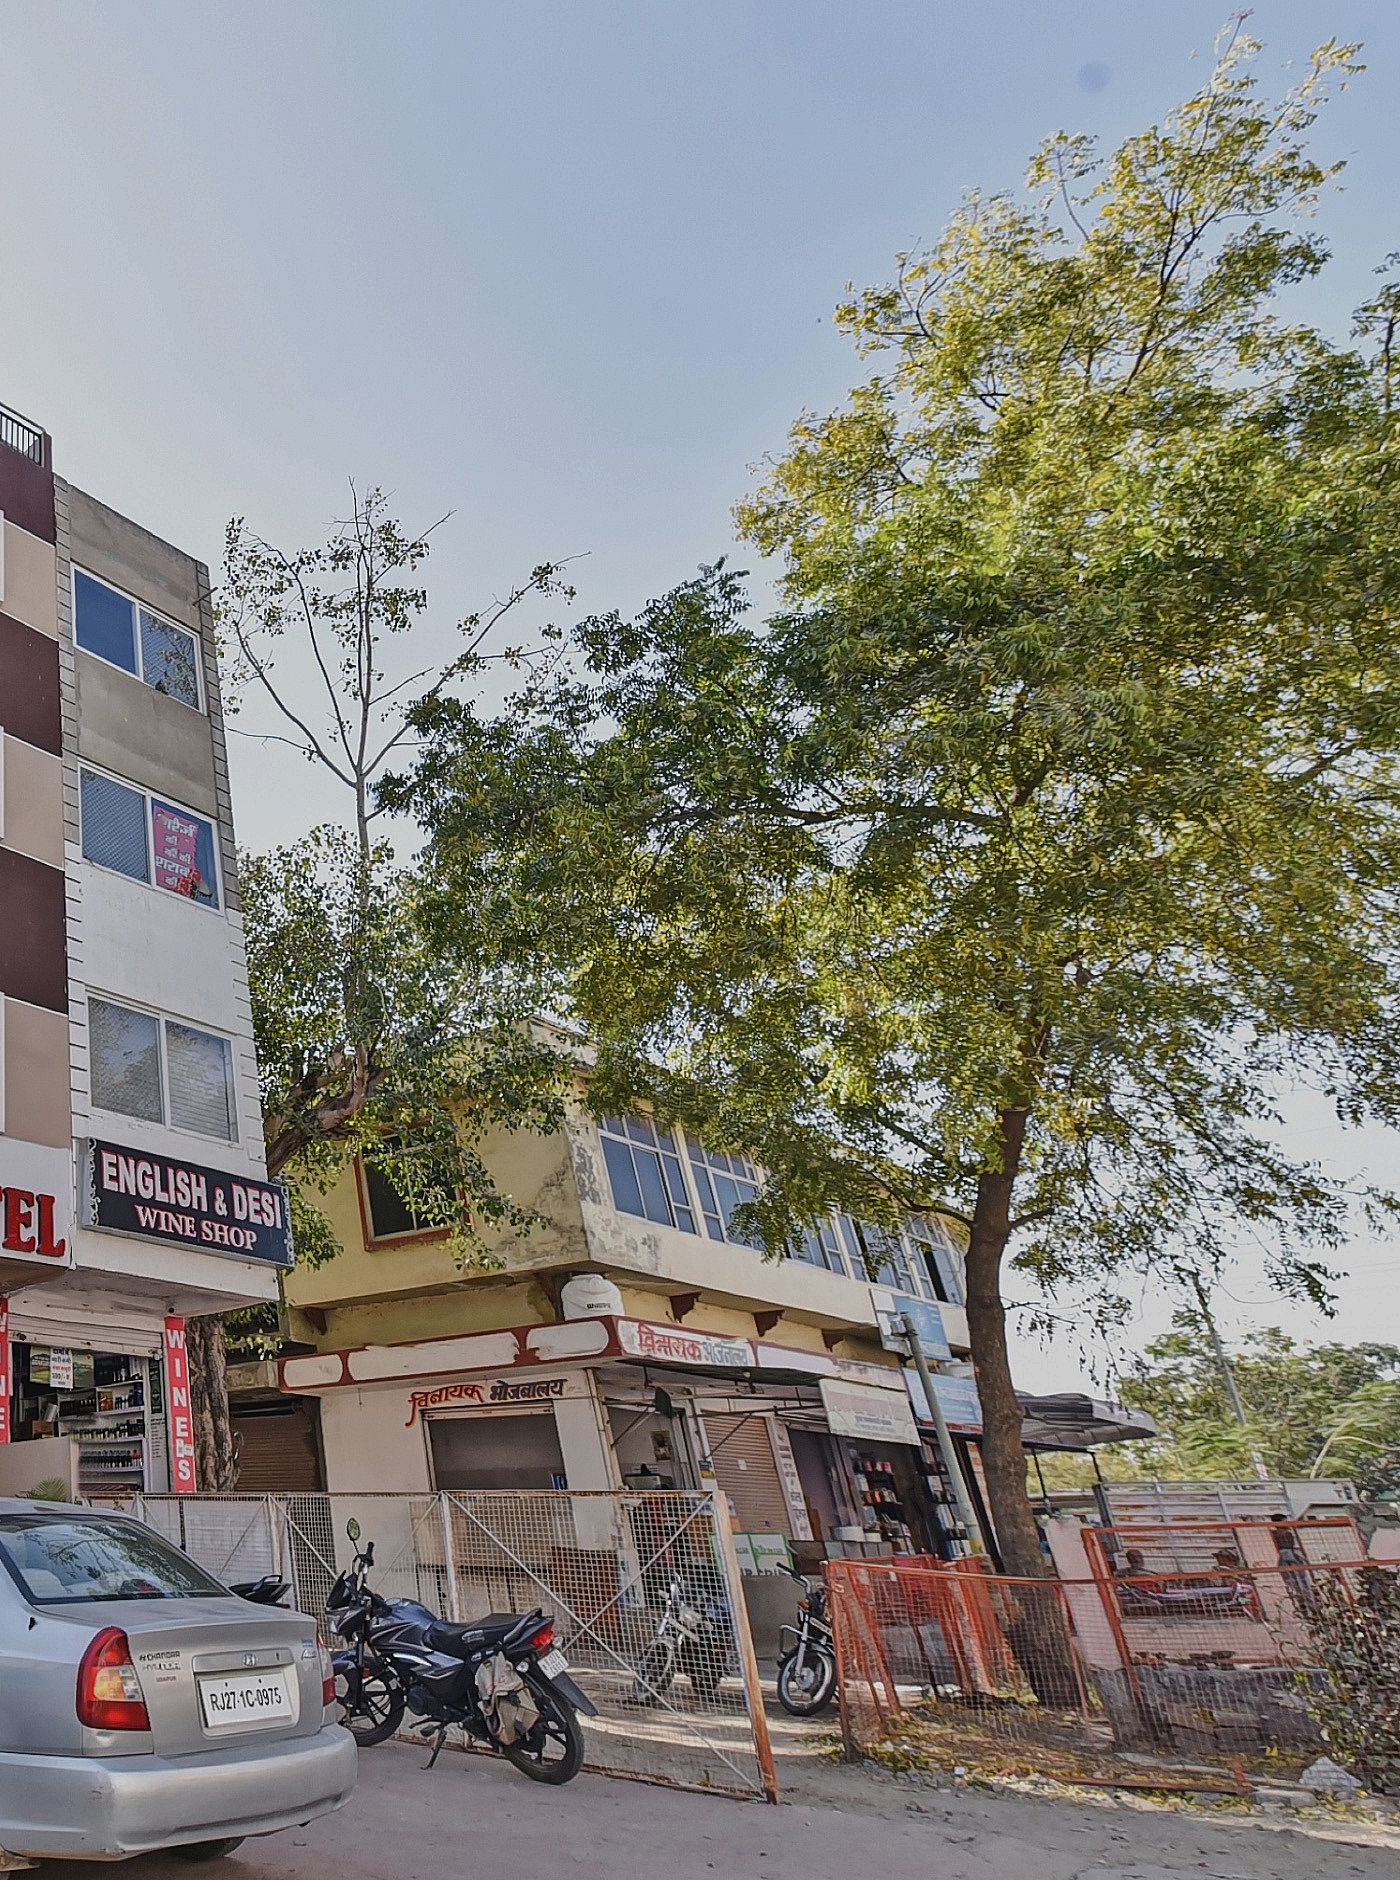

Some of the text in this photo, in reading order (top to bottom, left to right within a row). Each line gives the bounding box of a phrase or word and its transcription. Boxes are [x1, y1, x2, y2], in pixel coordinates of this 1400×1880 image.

[101, 1150, 283, 1230] ENGLISH & DESI
[134, 1204, 258, 1251] WINE SHOP
[405, 1384, 485, 1426] विनायक
